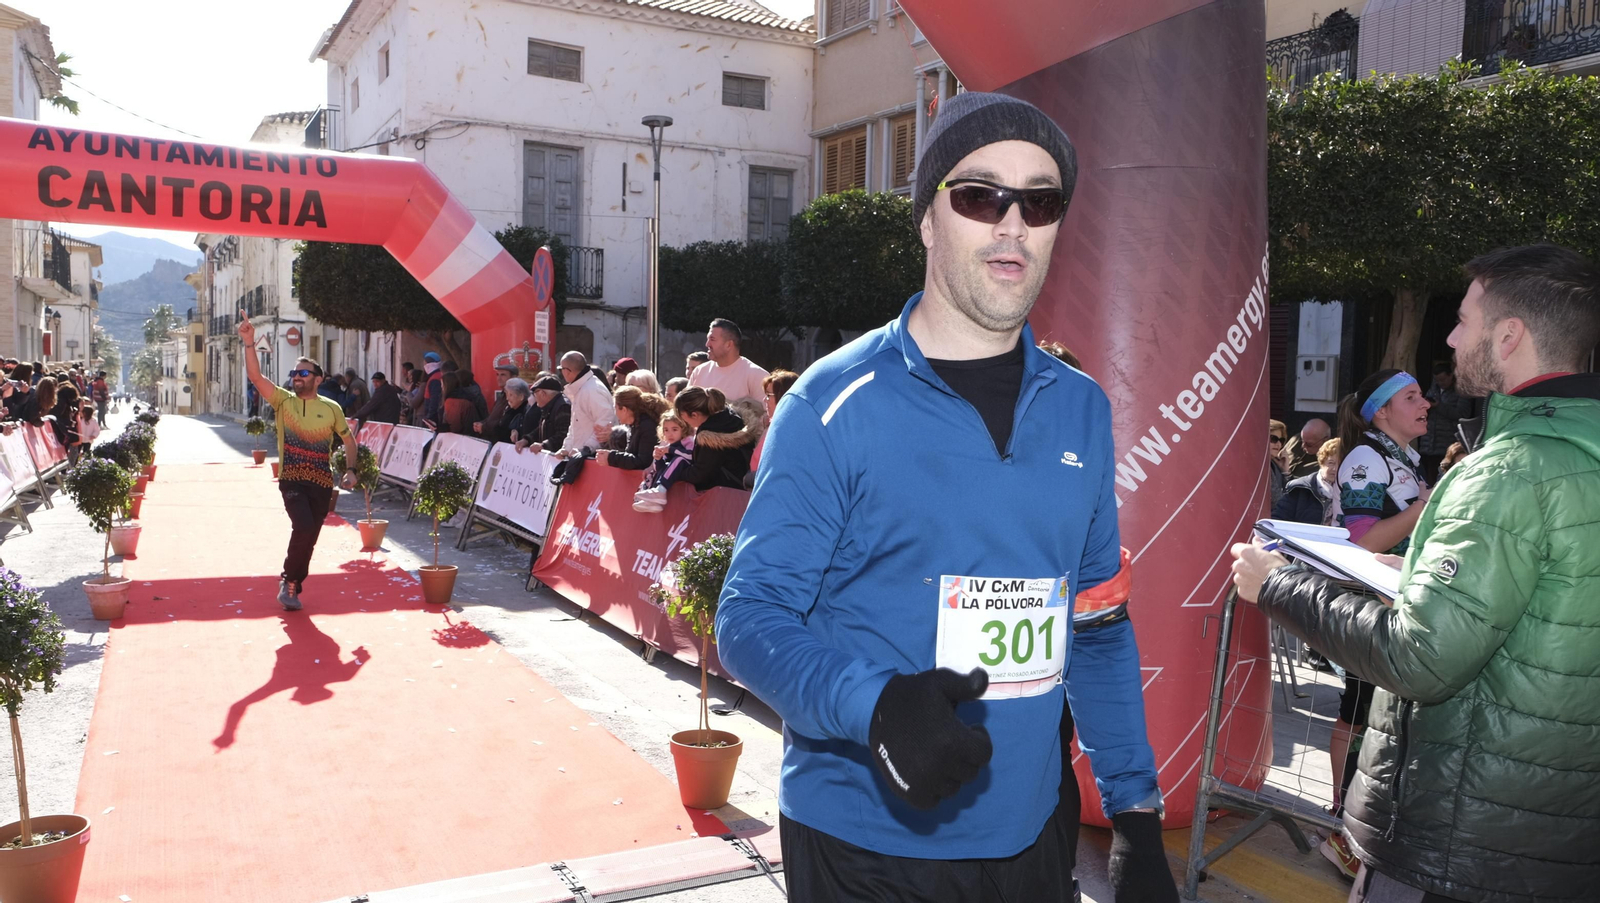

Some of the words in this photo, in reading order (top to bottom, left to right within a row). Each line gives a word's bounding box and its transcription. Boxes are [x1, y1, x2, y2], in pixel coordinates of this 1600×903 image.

[28, 127, 338, 178] AYUNTAMIENTO
[37, 165, 328, 229] CANTORIA
[493, 474, 551, 514] CANTORIA
[961, 597, 980, 610] LA
[985, 596, 1043, 610] PÓLVORA
[969, 579, 987, 593] IV
[991, 580, 1026, 593] CxM
[978, 615, 1056, 667] 301
